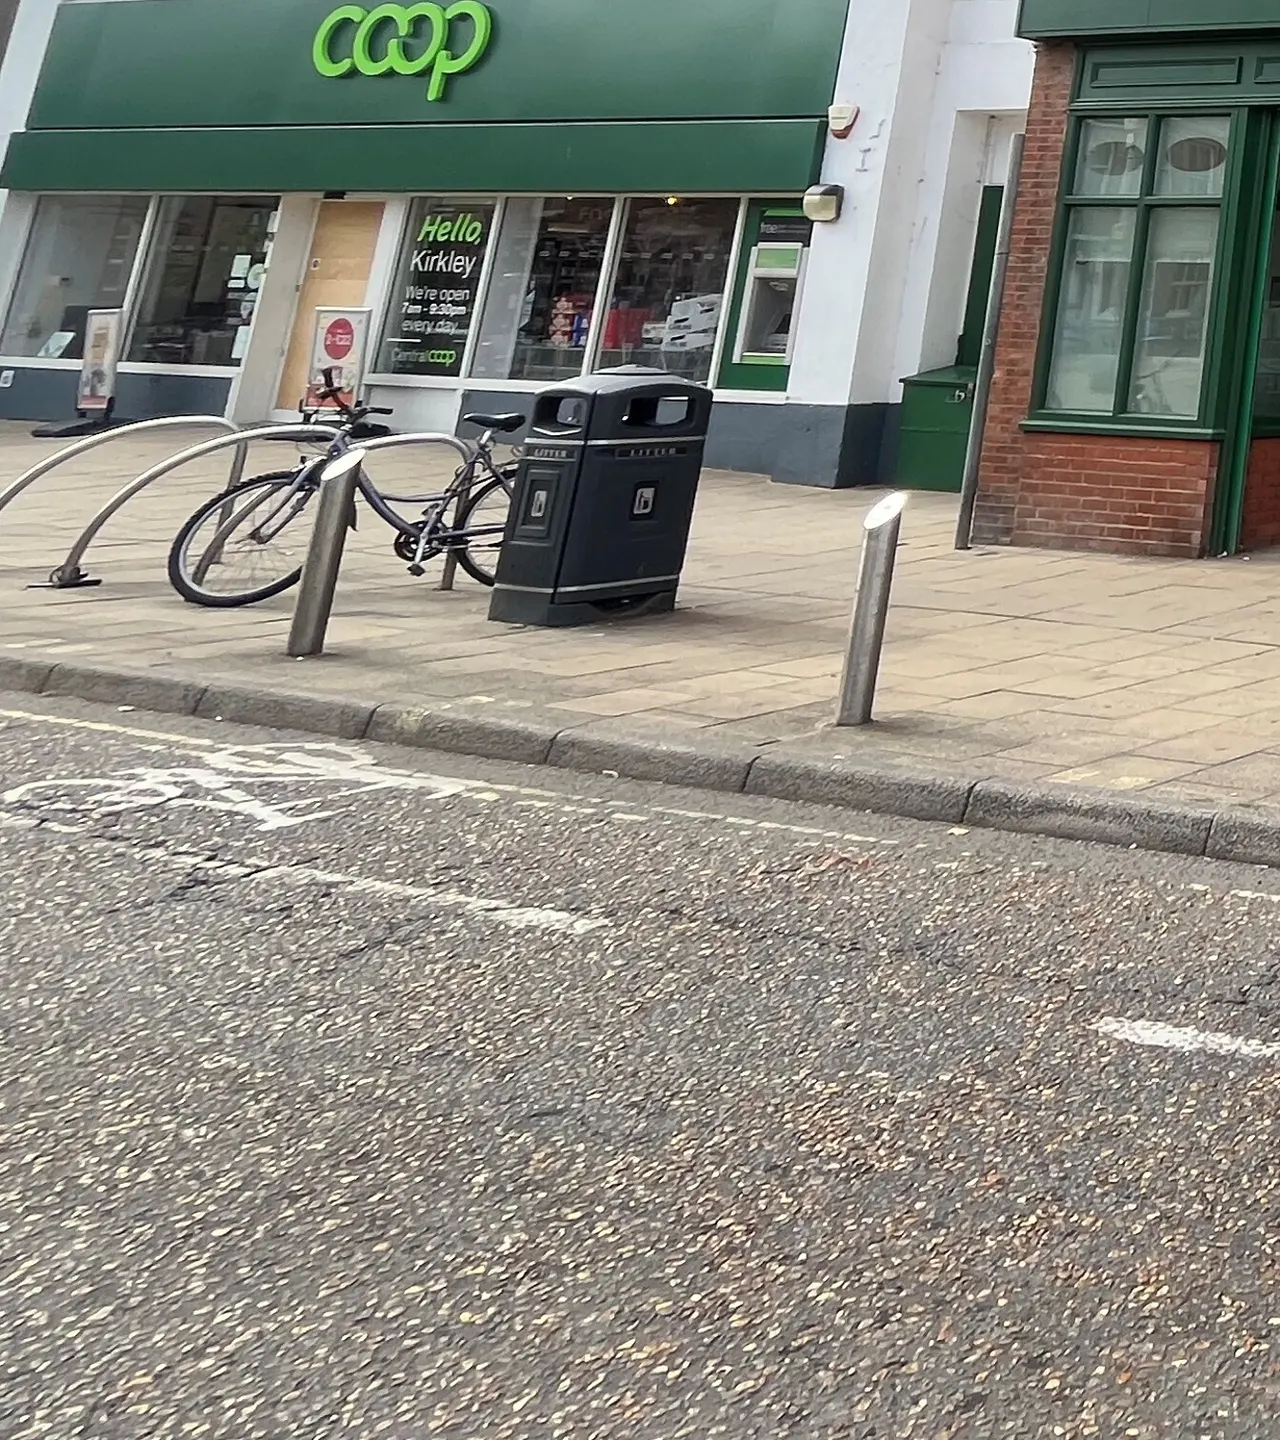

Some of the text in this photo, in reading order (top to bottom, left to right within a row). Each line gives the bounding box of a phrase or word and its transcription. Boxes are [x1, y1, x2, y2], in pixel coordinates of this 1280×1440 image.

[417, 213, 482, 245] Hello,
[410, 250, 477, 278] Kirkley
[405, 286, 470, 303] We're open
[401, 319, 434, 334] every
